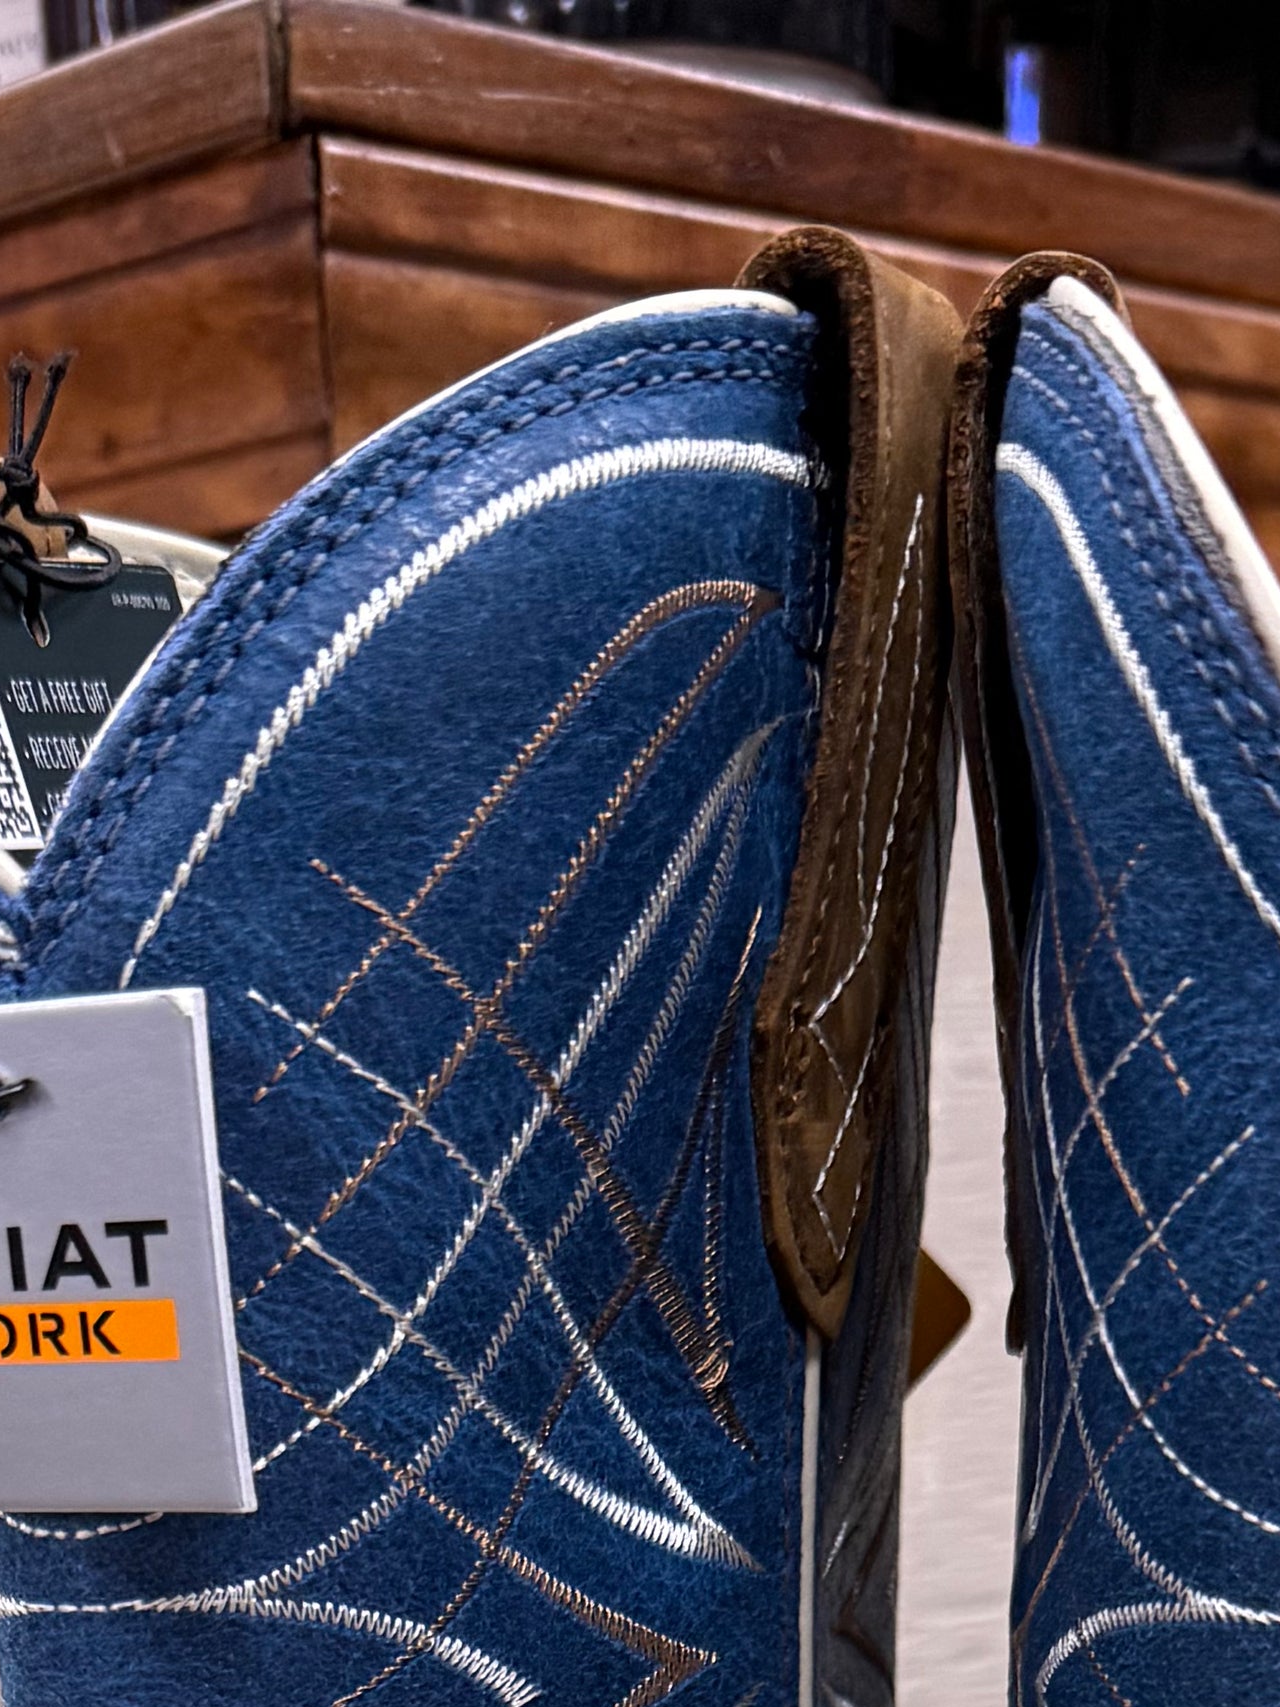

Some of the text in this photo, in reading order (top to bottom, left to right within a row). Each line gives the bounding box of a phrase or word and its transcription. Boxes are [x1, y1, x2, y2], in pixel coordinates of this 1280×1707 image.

[11, 679, 113, 713] GET A FREE GIFT
[28, 735, 81, 769] RECEIVE
